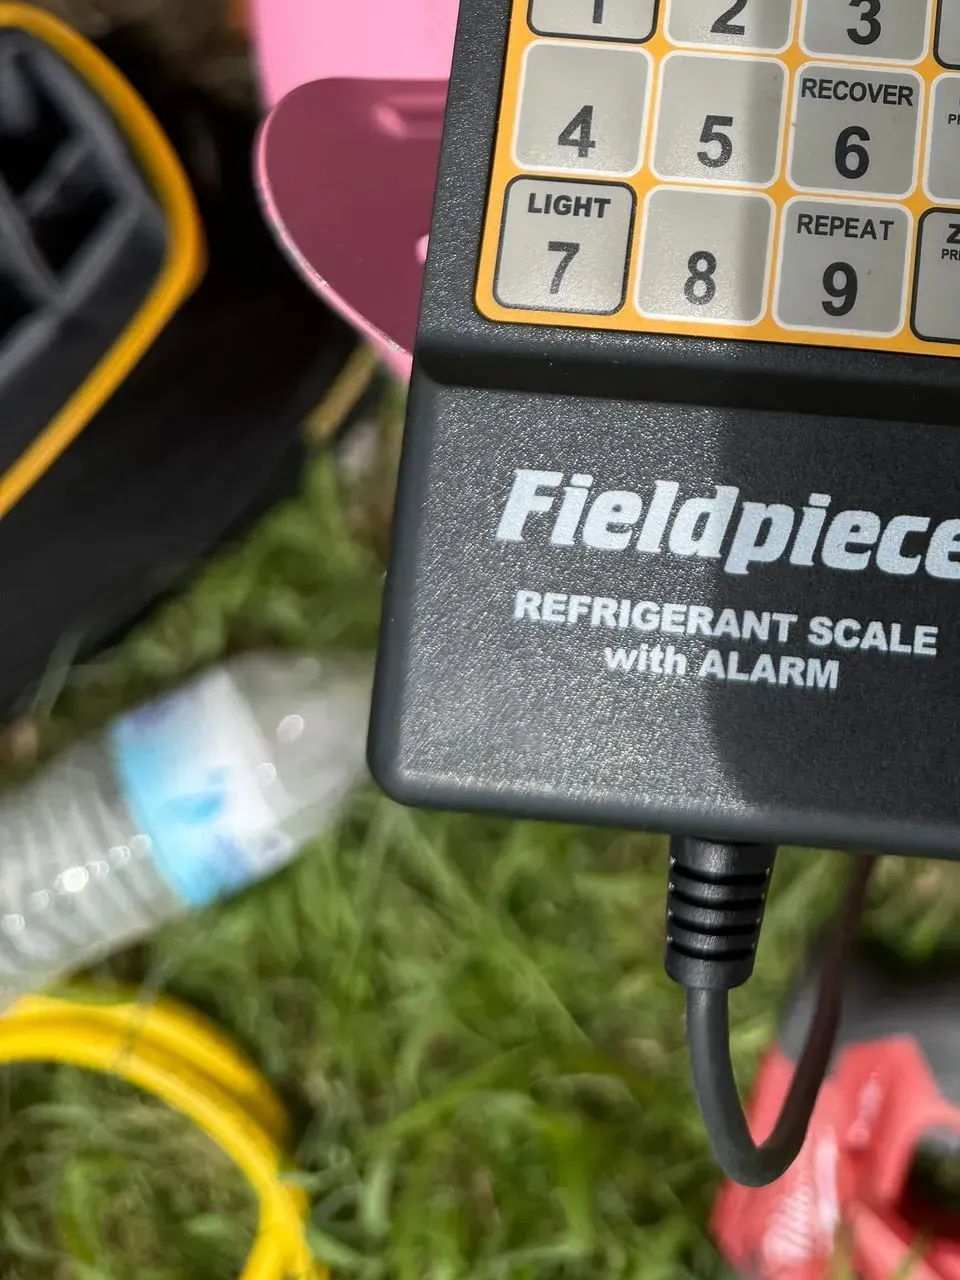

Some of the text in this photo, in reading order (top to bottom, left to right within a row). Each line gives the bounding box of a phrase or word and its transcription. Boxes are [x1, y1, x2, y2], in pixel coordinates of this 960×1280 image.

[800, 77, 914, 107] RECOVER
[557, 104, 597, 158] 4
[696, 115, 734, 168] 5
[833, 125, 870, 180] 6
[527, 192, 611, 219] LIGHT
[797, 213, 894, 241] REPEAT
[547, 241, 580, 295] 7
[684, 250, 717, 305] 8
[821, 262, 858, 316] 9
[513, 590, 938, 656] REFRIGERANT SCALE
[604, 644, 839, 690] with ALARM
